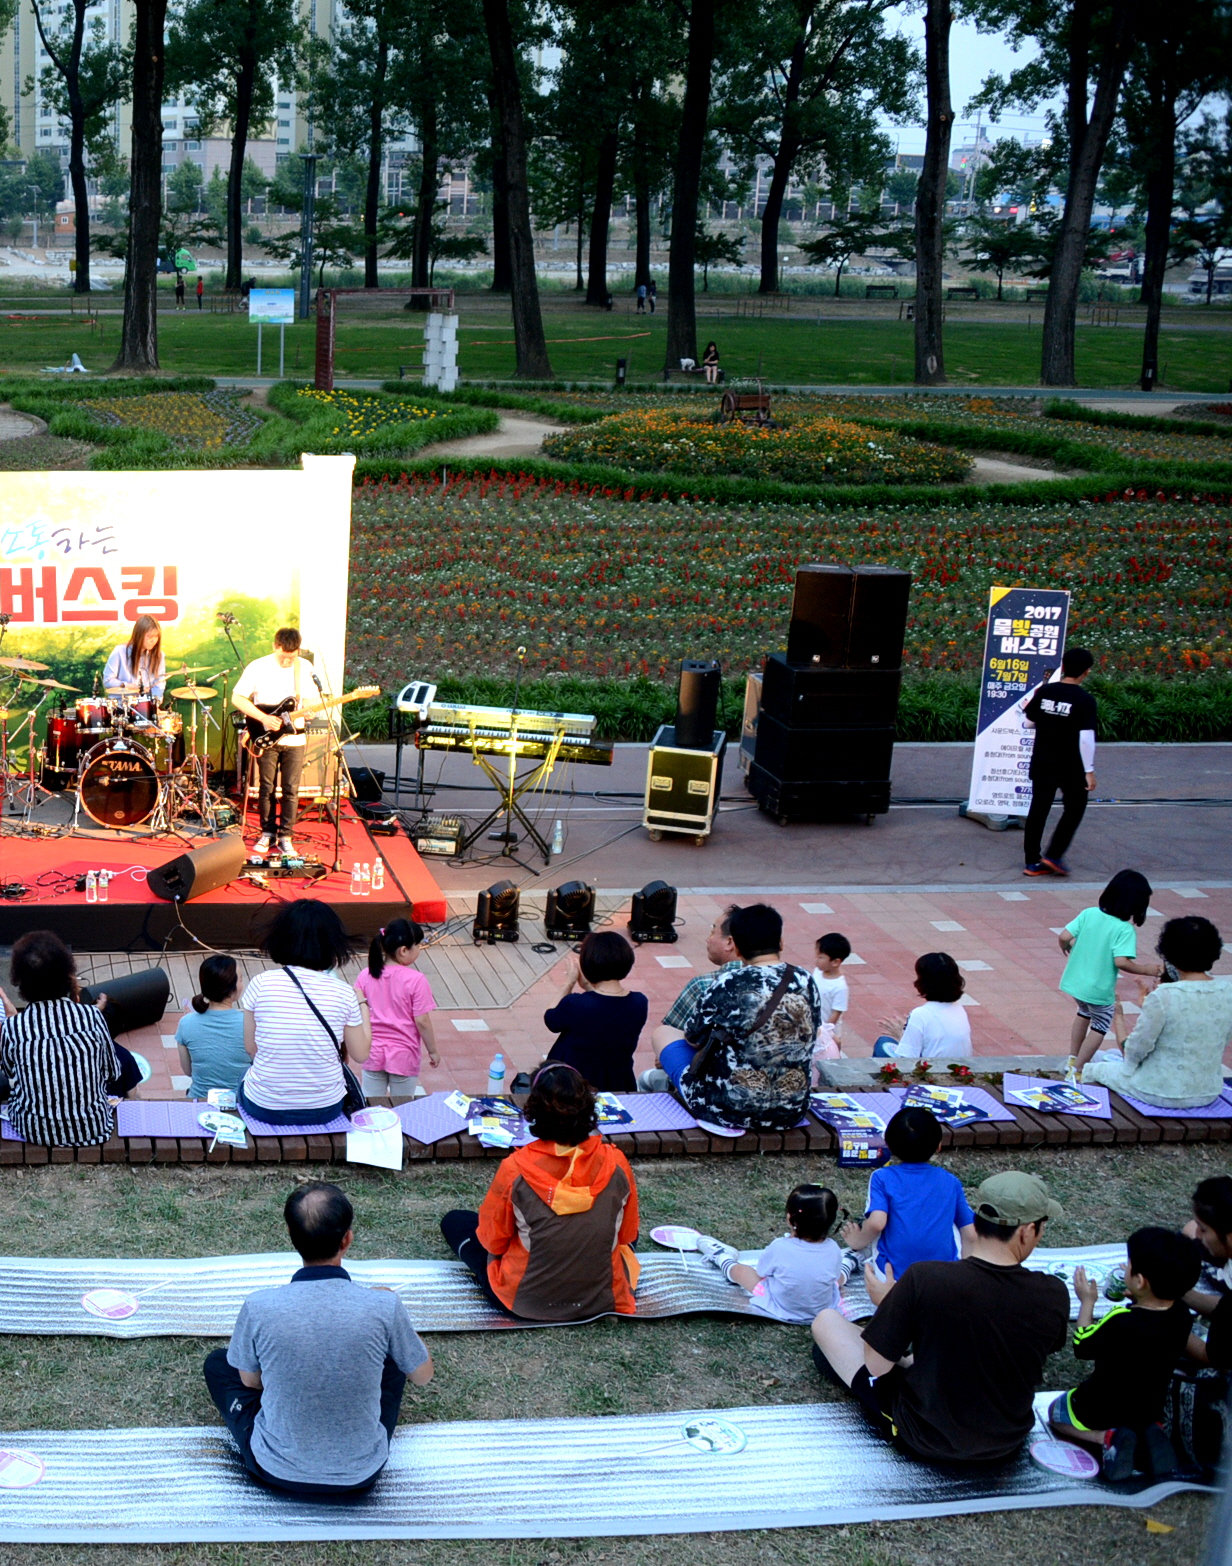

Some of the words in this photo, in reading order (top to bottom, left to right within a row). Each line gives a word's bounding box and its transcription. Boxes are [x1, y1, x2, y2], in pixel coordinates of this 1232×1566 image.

[1, 520, 119, 560] 소통하는
[0, 566, 179, 623] 버스킹
[1024, 605, 1062, 620] 2017
[993, 618, 1060, 638] 물빛공원
[1000, 637, 1058, 656] 버스킹
[989, 658, 1029, 671] 6월16일
[987, 681, 1002, 690] 매주
[1004, 682, 1027, 691] 금요일
[986, 690, 1007, 698] 19:30
[105, 761, 143, 772] TAMA
